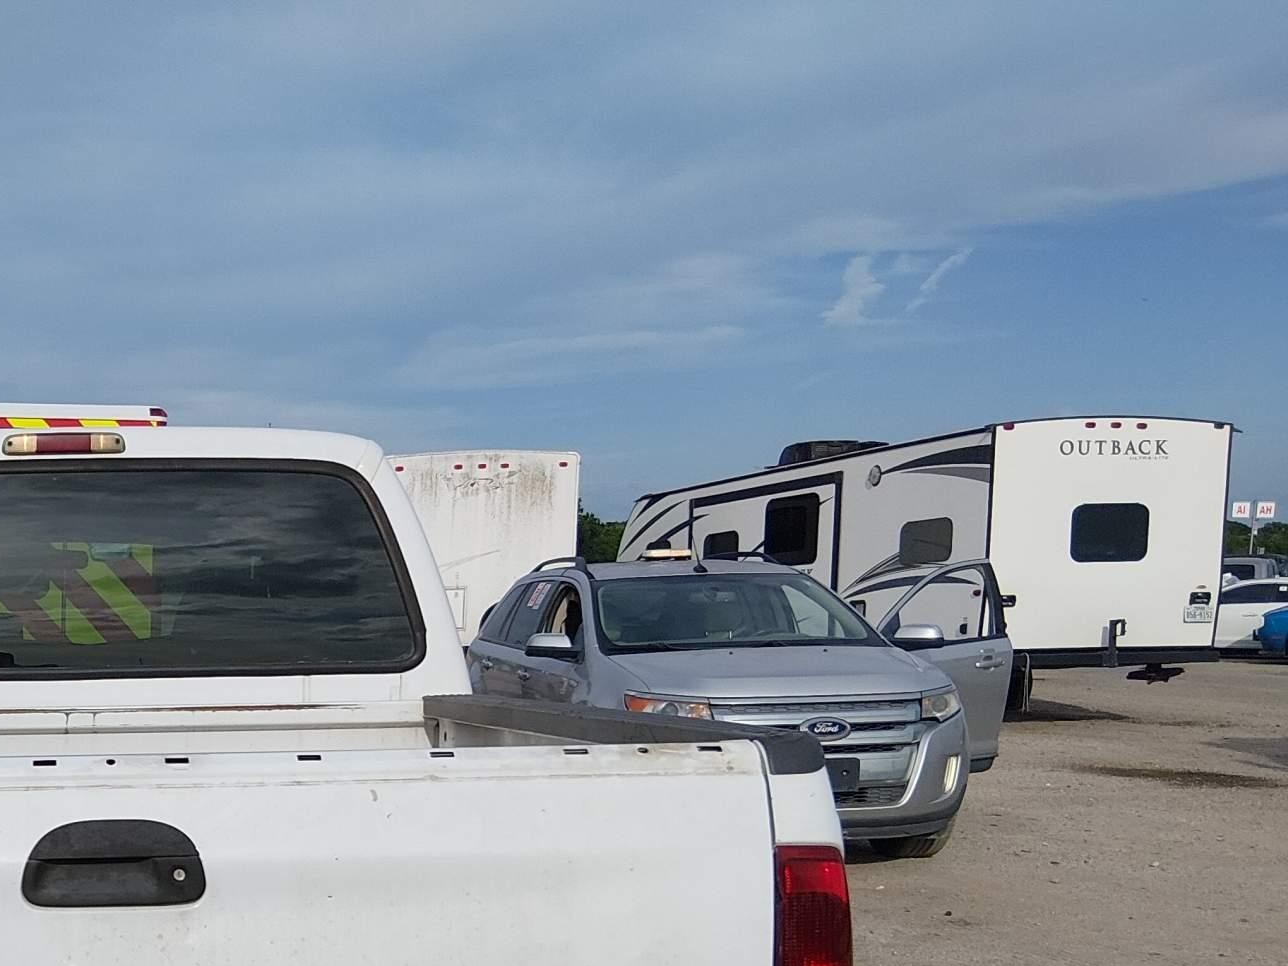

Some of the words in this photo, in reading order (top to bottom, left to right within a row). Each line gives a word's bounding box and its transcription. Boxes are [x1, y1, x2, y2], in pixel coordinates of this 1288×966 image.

[1059, 439, 1169, 456] OUTBACK
[1259, 505, 1272, 515] AH
[813, 722, 840, 733] Ford
